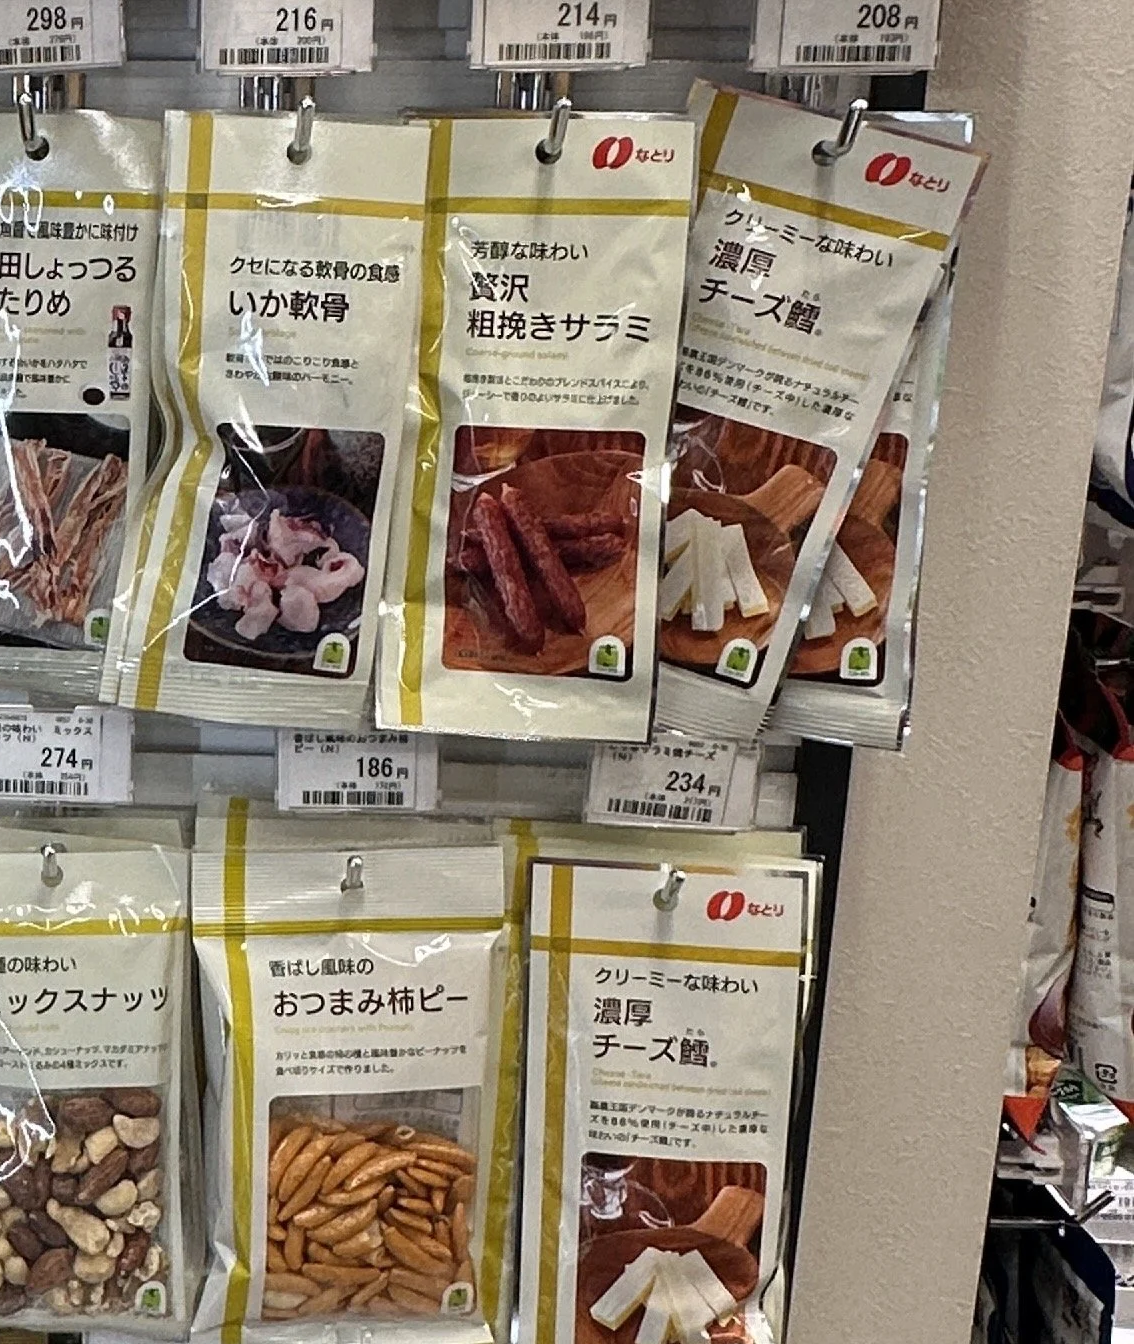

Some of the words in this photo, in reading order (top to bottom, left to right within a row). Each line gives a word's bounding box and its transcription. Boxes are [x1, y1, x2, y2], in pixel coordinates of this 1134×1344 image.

[634, 147, 675, 164] なとり
[907, 171, 951, 193] なとり
[470, 240, 589, 262] 芳醇な味わい
[724, 208, 895, 269] クリーミーな味わい
[229, 255, 401, 284] クセになる軟骨の食感
[708, 237, 778, 279] 濃厚
[468, 271, 530, 303] 贅沢
[228, 288, 351, 324] いか軟骨
[698, 277, 822, 336] チーズ鱈
[466, 308, 653, 344] 粗挽きサラミ
[746, 902, 785, 918] なとり
[269, 957, 375, 978] 香ばし風味の
[594, 966, 760, 994] クリーミーな味わい
[273, 983, 469, 1018] おつまみ柿ピー
[592, 996, 654, 1027] 濃厚
[592, 1032, 717, 1068] チーズ鱈
